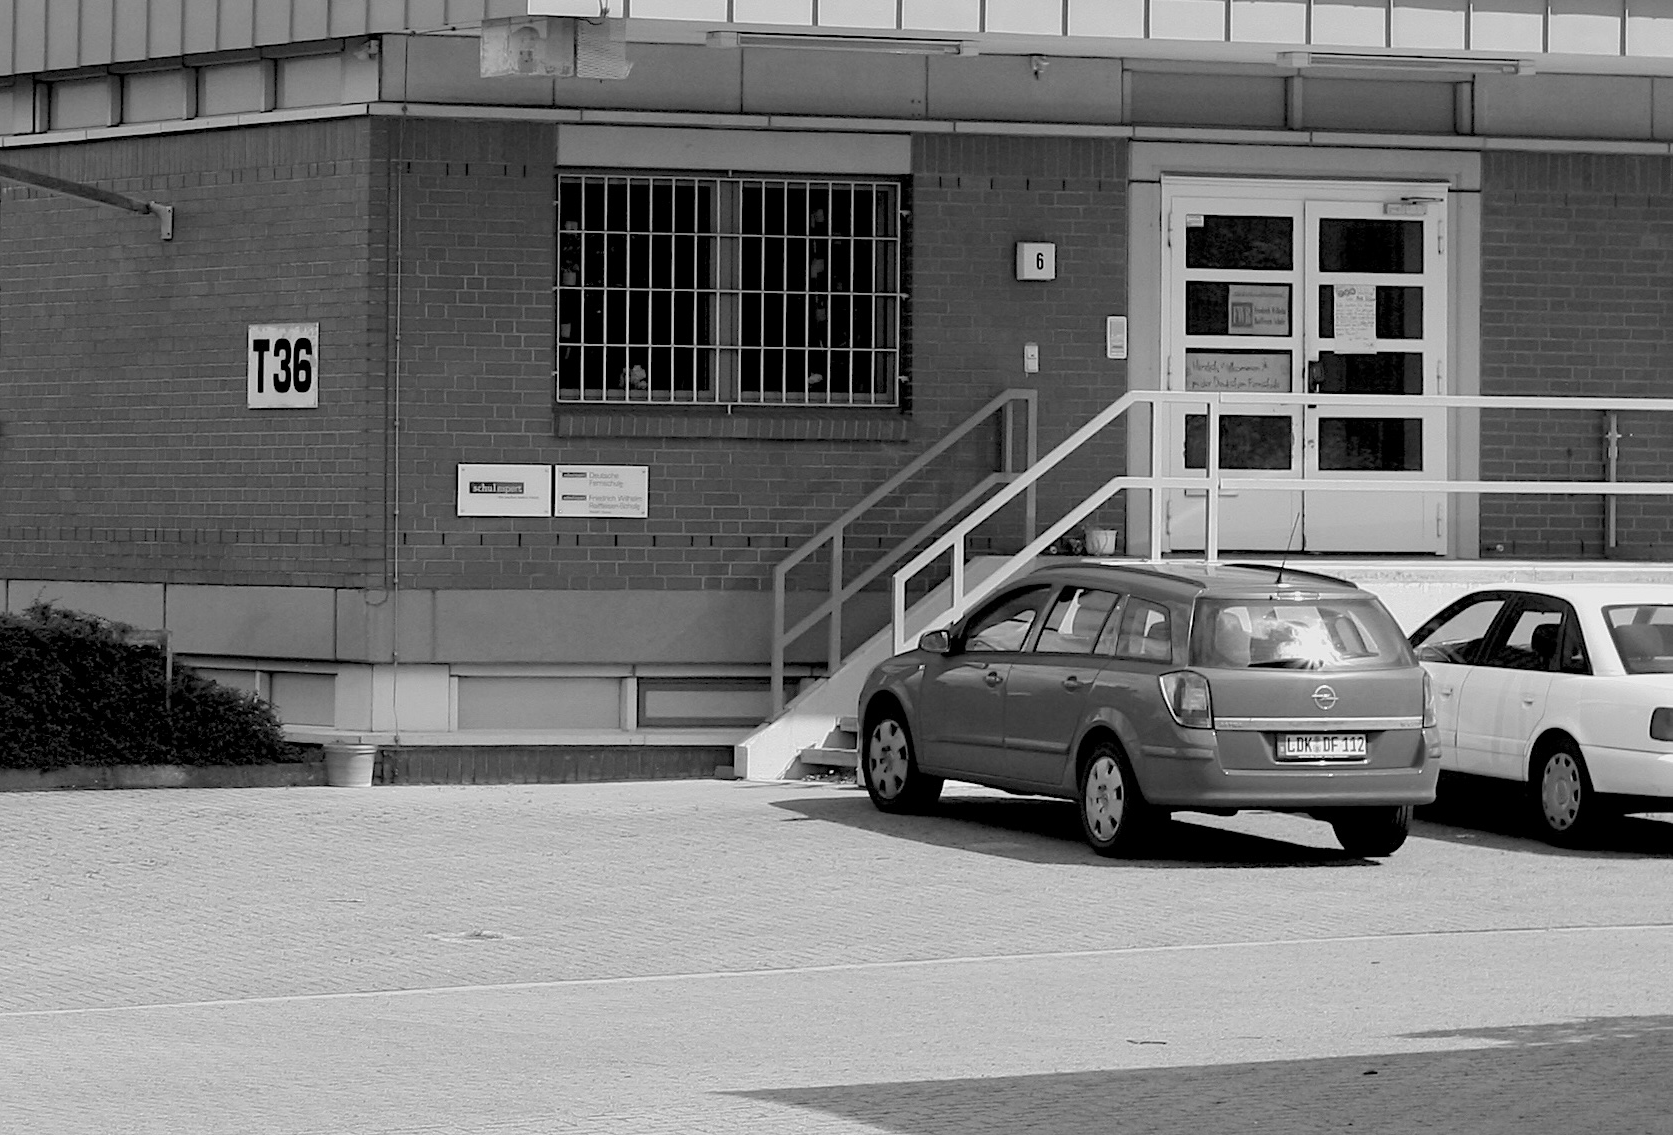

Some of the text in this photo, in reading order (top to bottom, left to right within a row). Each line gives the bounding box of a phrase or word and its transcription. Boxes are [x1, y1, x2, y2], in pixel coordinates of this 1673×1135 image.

[1036, 252, 1044, 270] 6
[1287, 736, 1365, 753] LDK DF 112
